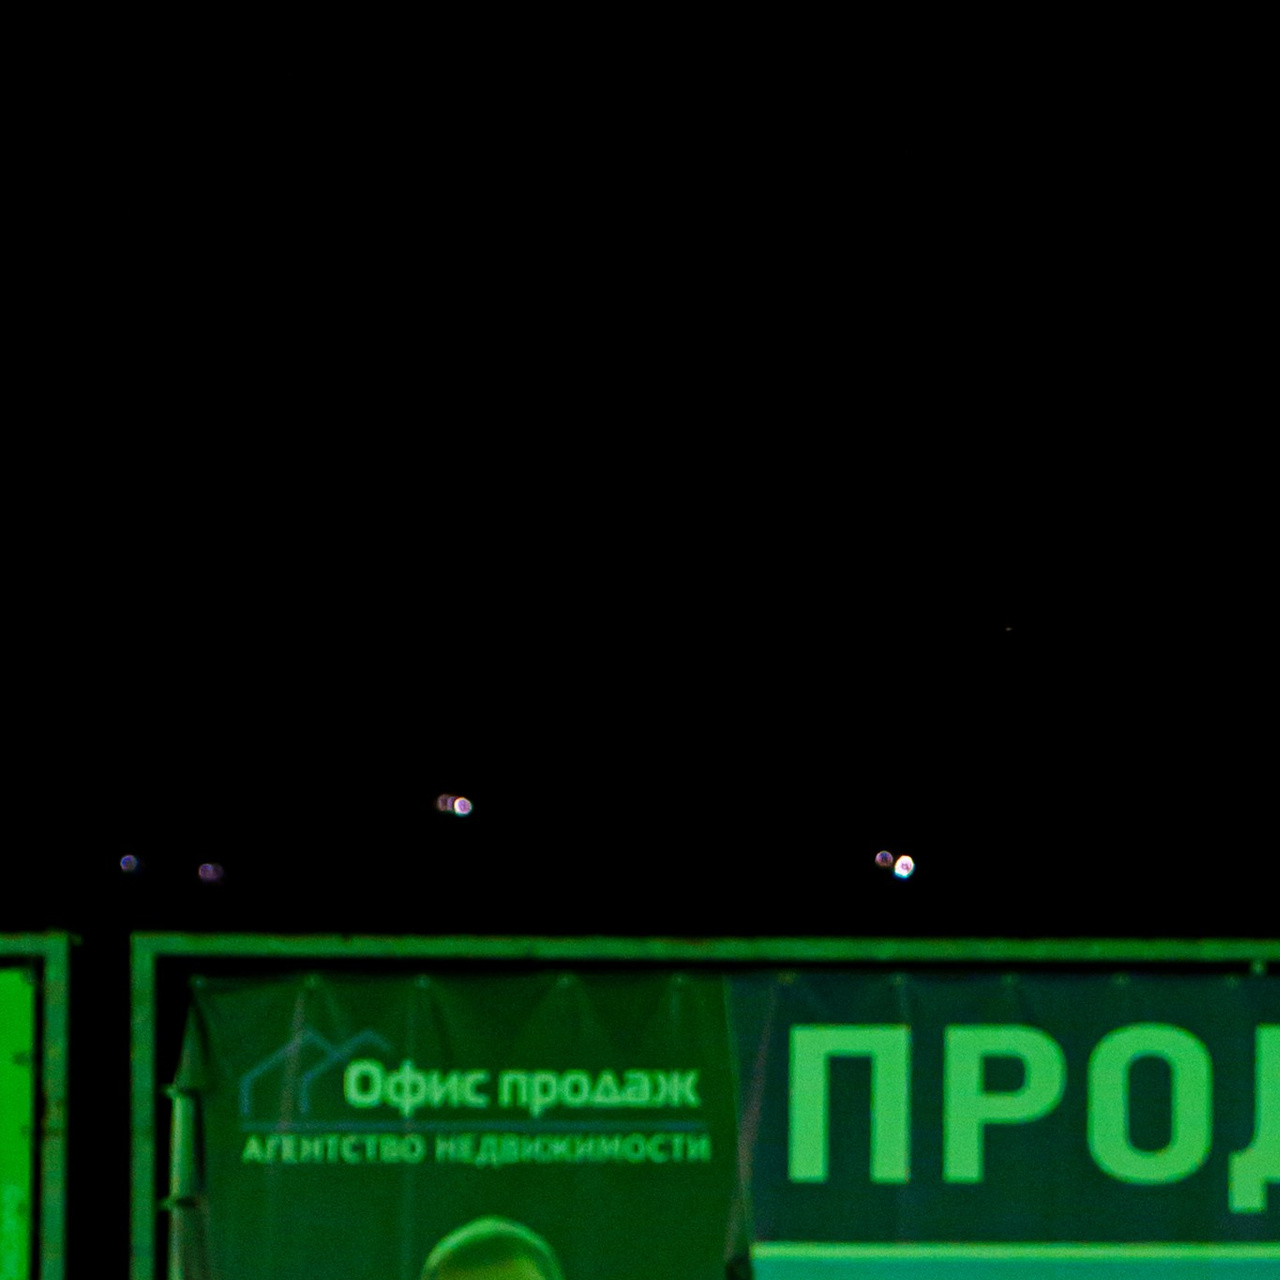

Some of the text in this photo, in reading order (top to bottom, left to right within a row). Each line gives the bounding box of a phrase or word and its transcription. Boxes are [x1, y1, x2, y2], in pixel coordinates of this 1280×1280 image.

[343, 1058, 701, 1119] Офис продаж
[241, 1131, 712, 1168] АГЕНТСТВО НЕДВИЖИМОСТИ
